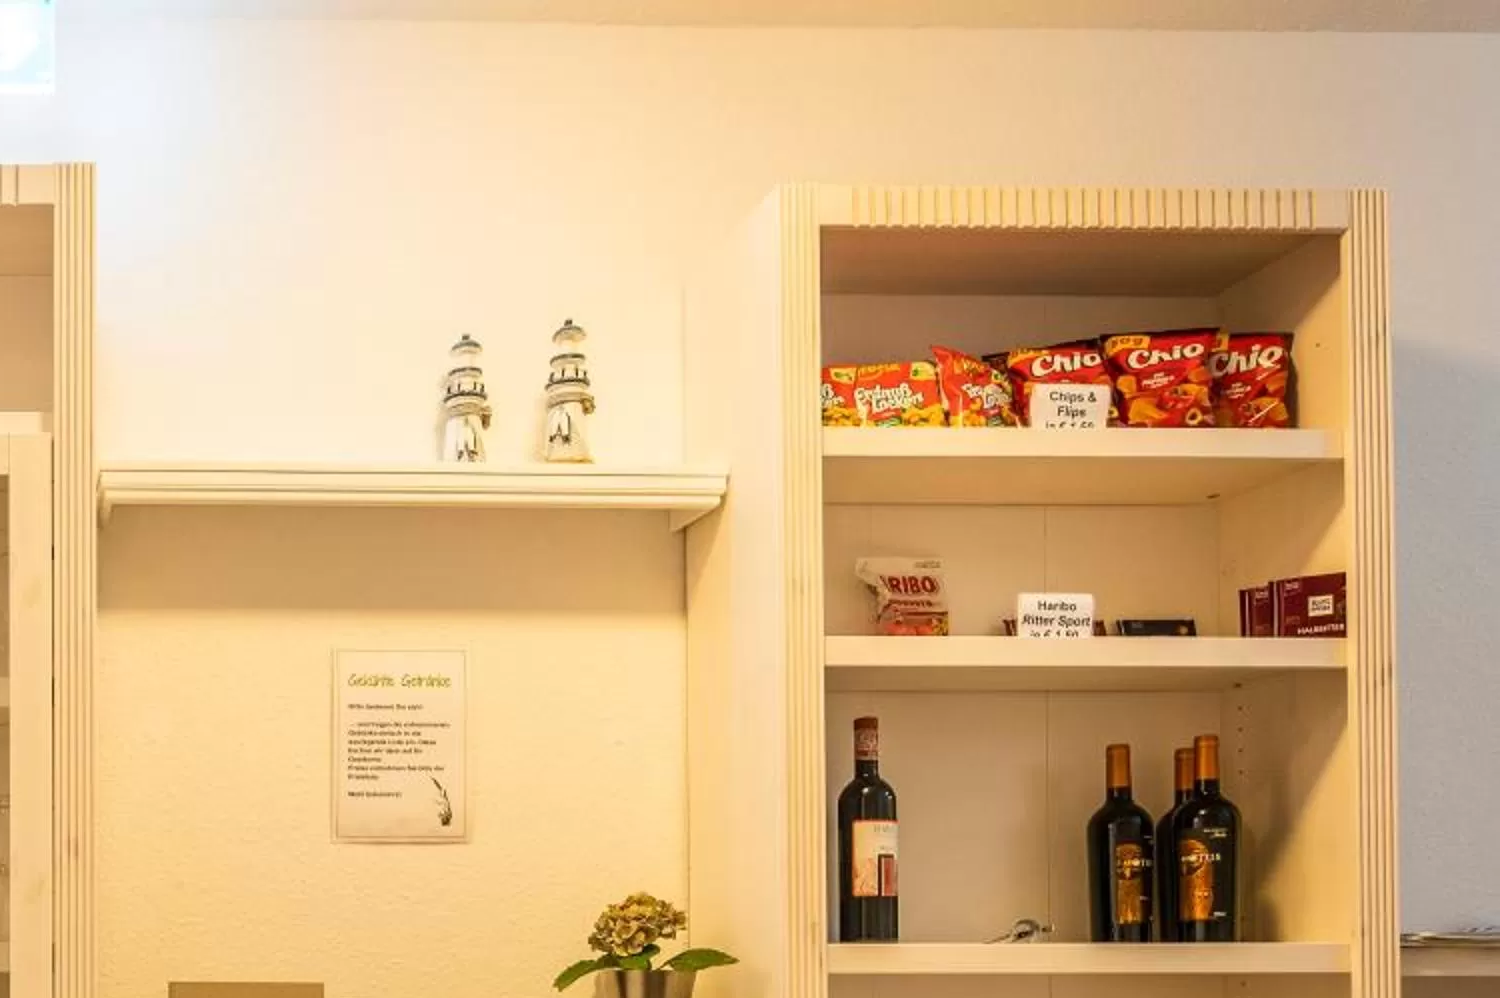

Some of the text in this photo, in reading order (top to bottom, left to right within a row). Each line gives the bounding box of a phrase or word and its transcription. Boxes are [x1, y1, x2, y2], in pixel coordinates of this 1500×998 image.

[1031, 350, 1101, 377] Chio
[1127, 342, 1204, 370] Chio
[1209, 343, 1284, 377] Chio
[1049, 390, 1097, 404] Chips &
[1057, 405, 1087, 418] Flips
[887, 575, 938, 593] RIBO
[1037, 600, 1077, 612] Haribo
[1022, 614, 1091, 628] Ritter Sport
